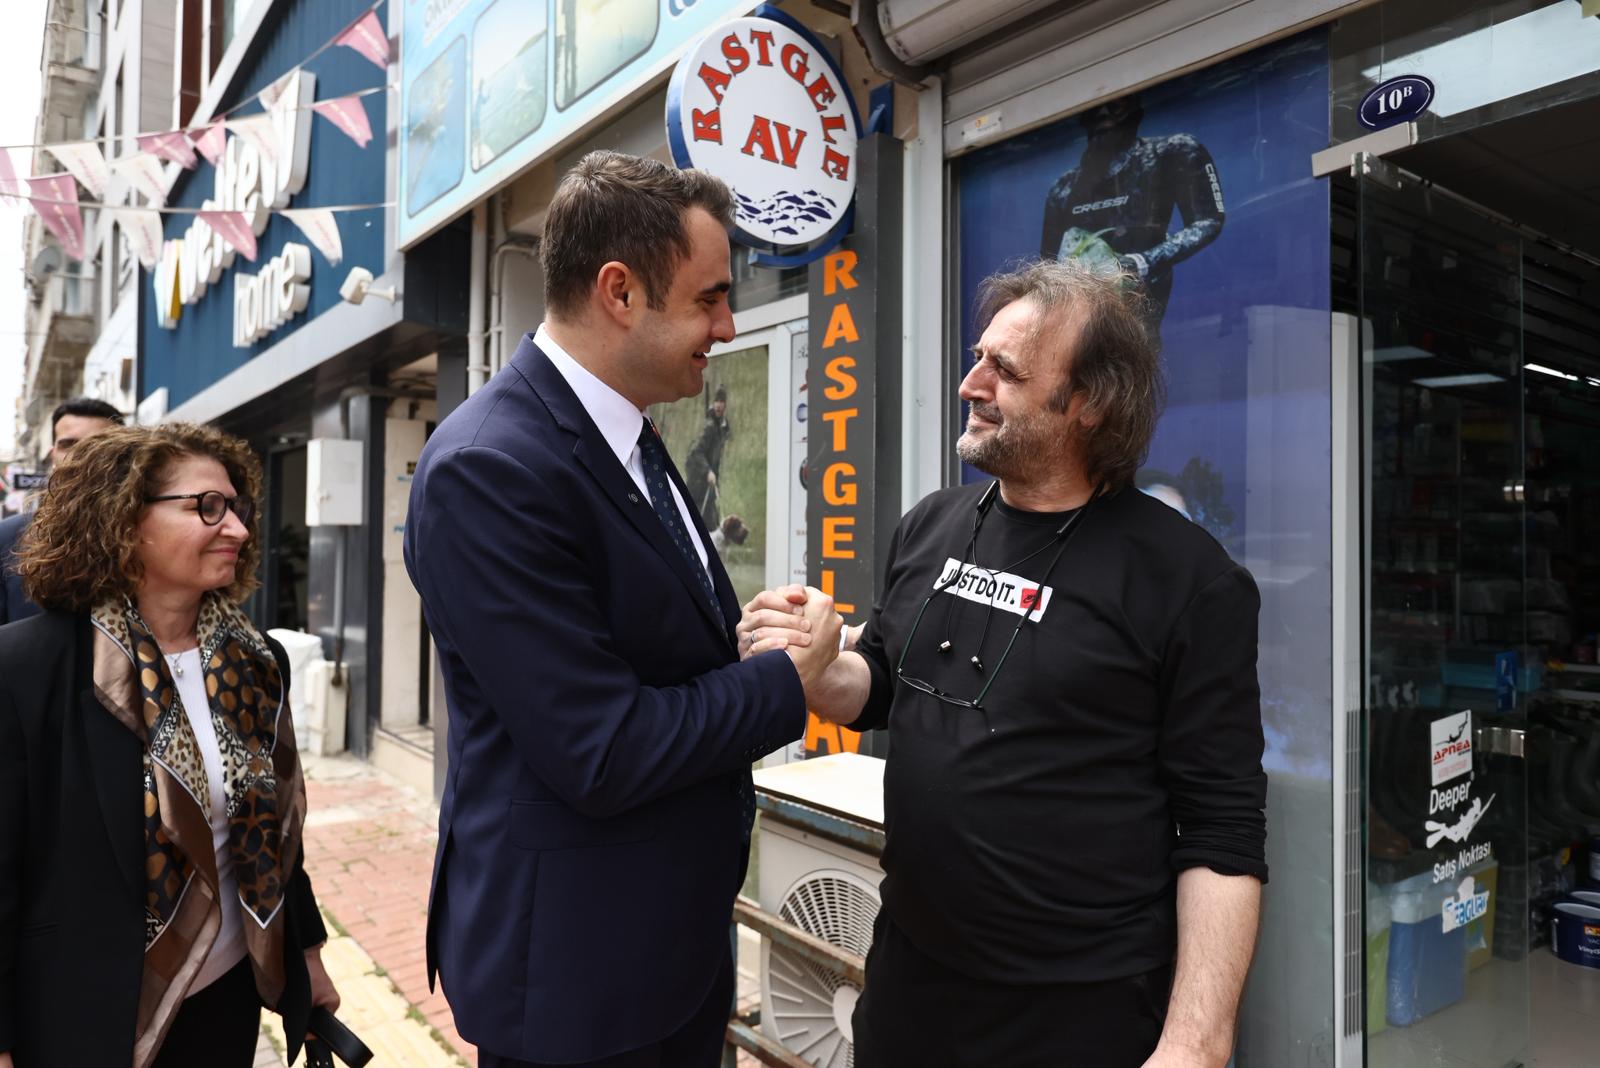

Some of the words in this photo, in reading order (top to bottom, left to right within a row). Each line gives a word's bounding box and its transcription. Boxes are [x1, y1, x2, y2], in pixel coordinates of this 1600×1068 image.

[692, 28, 851, 182] RASTGELE
[741, 115, 808, 169] AV
[1072, 195, 1129, 214] CRESSI
[1205, 163, 1225, 213] CRESSI
[822, 249, 859, 614] RASTGEL
[1433, 739, 1470, 761] APNEA
[1430, 781, 1471, 815] Deeper
[1432, 859, 1456, 884] Satış
